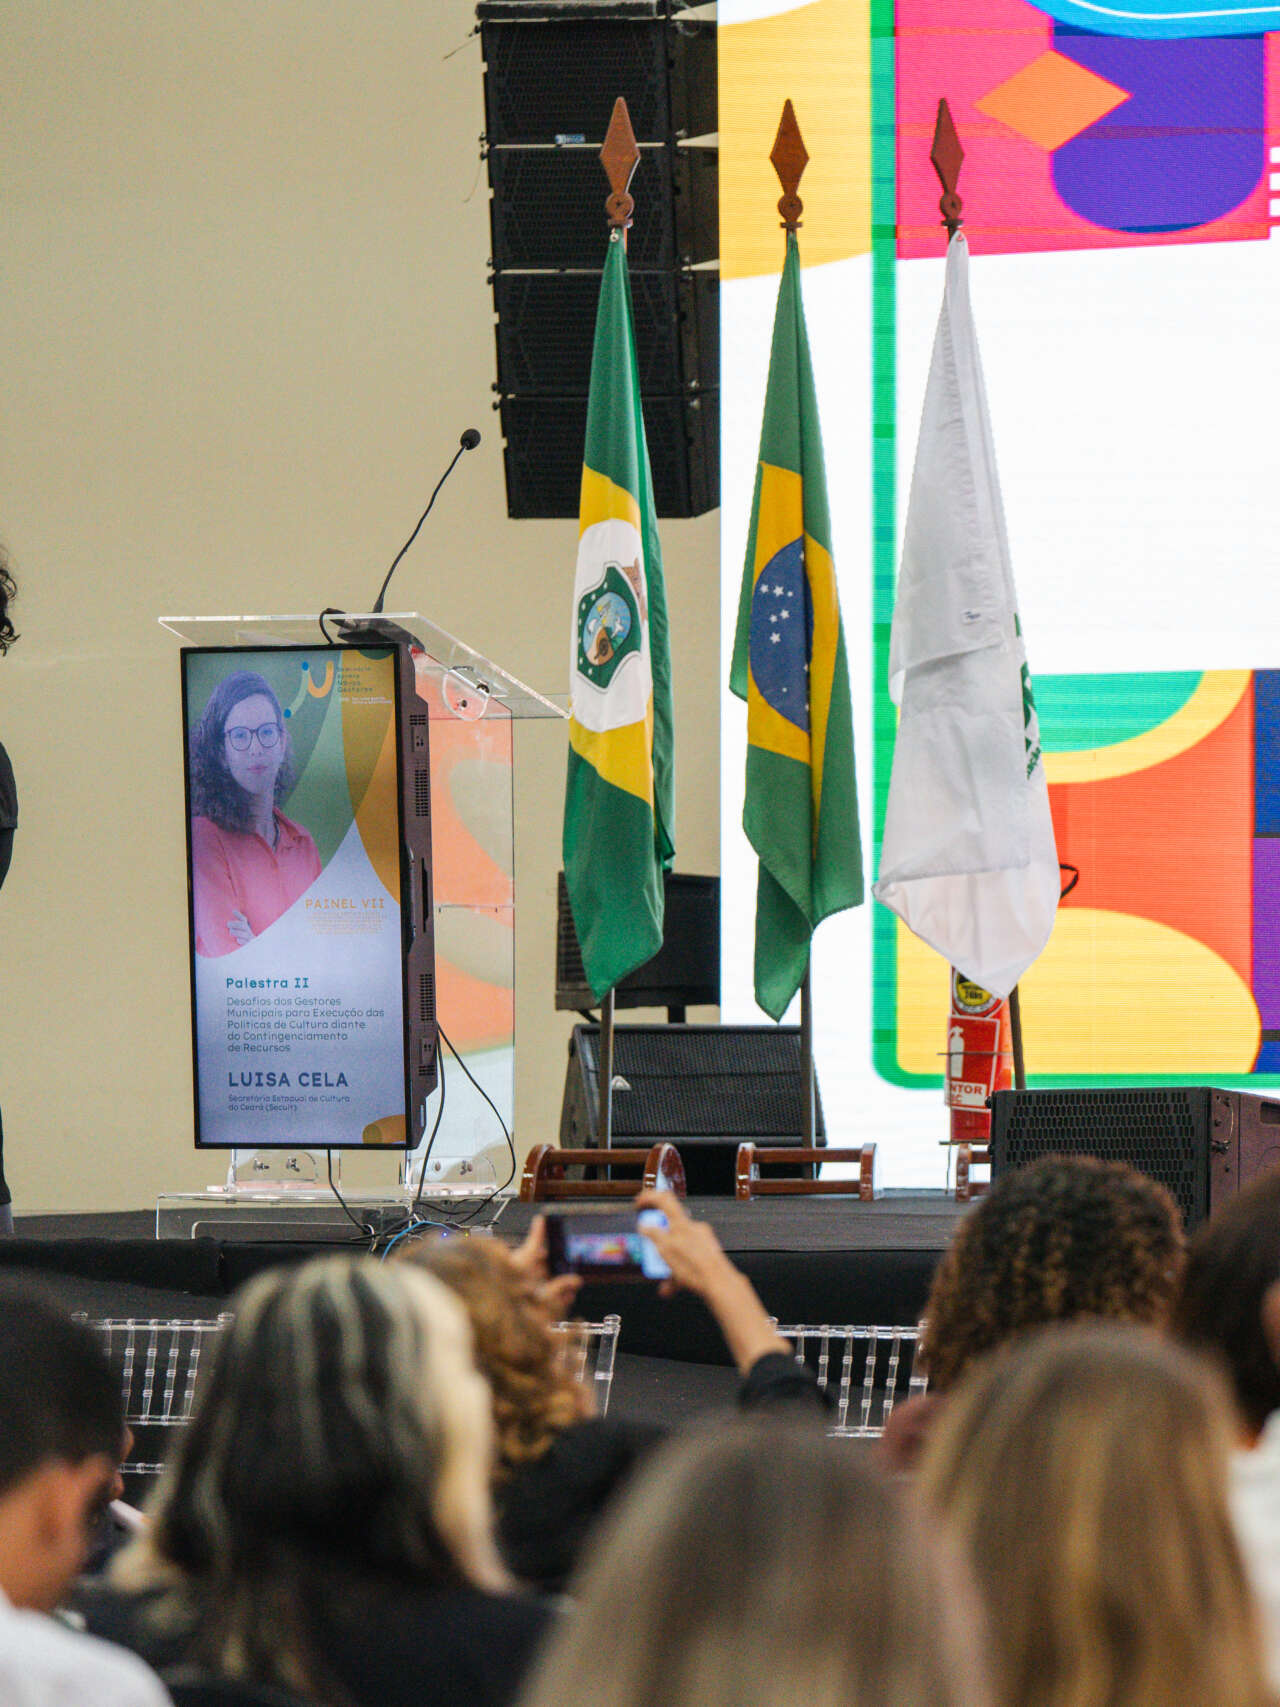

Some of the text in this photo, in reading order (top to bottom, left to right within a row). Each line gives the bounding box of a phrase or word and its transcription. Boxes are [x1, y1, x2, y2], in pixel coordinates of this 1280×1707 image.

[305, 898, 384, 909] PAINEL VII
[226, 977, 309, 989] Palestra II
[226, 997, 341, 1007] Desafios dos Gestores
[227, 1007, 385, 1019] Municipais para Execução das
[273, 1020, 287, 1029] de
[289, 1019, 329, 1029] Cultura
[330, 1019, 367, 1029] diante
[227, 1031, 348, 1043] do Contingenciamento
[227, 1043, 291, 1053] de Recursos
[228, 1071, 349, 1088] LUISA CELA
